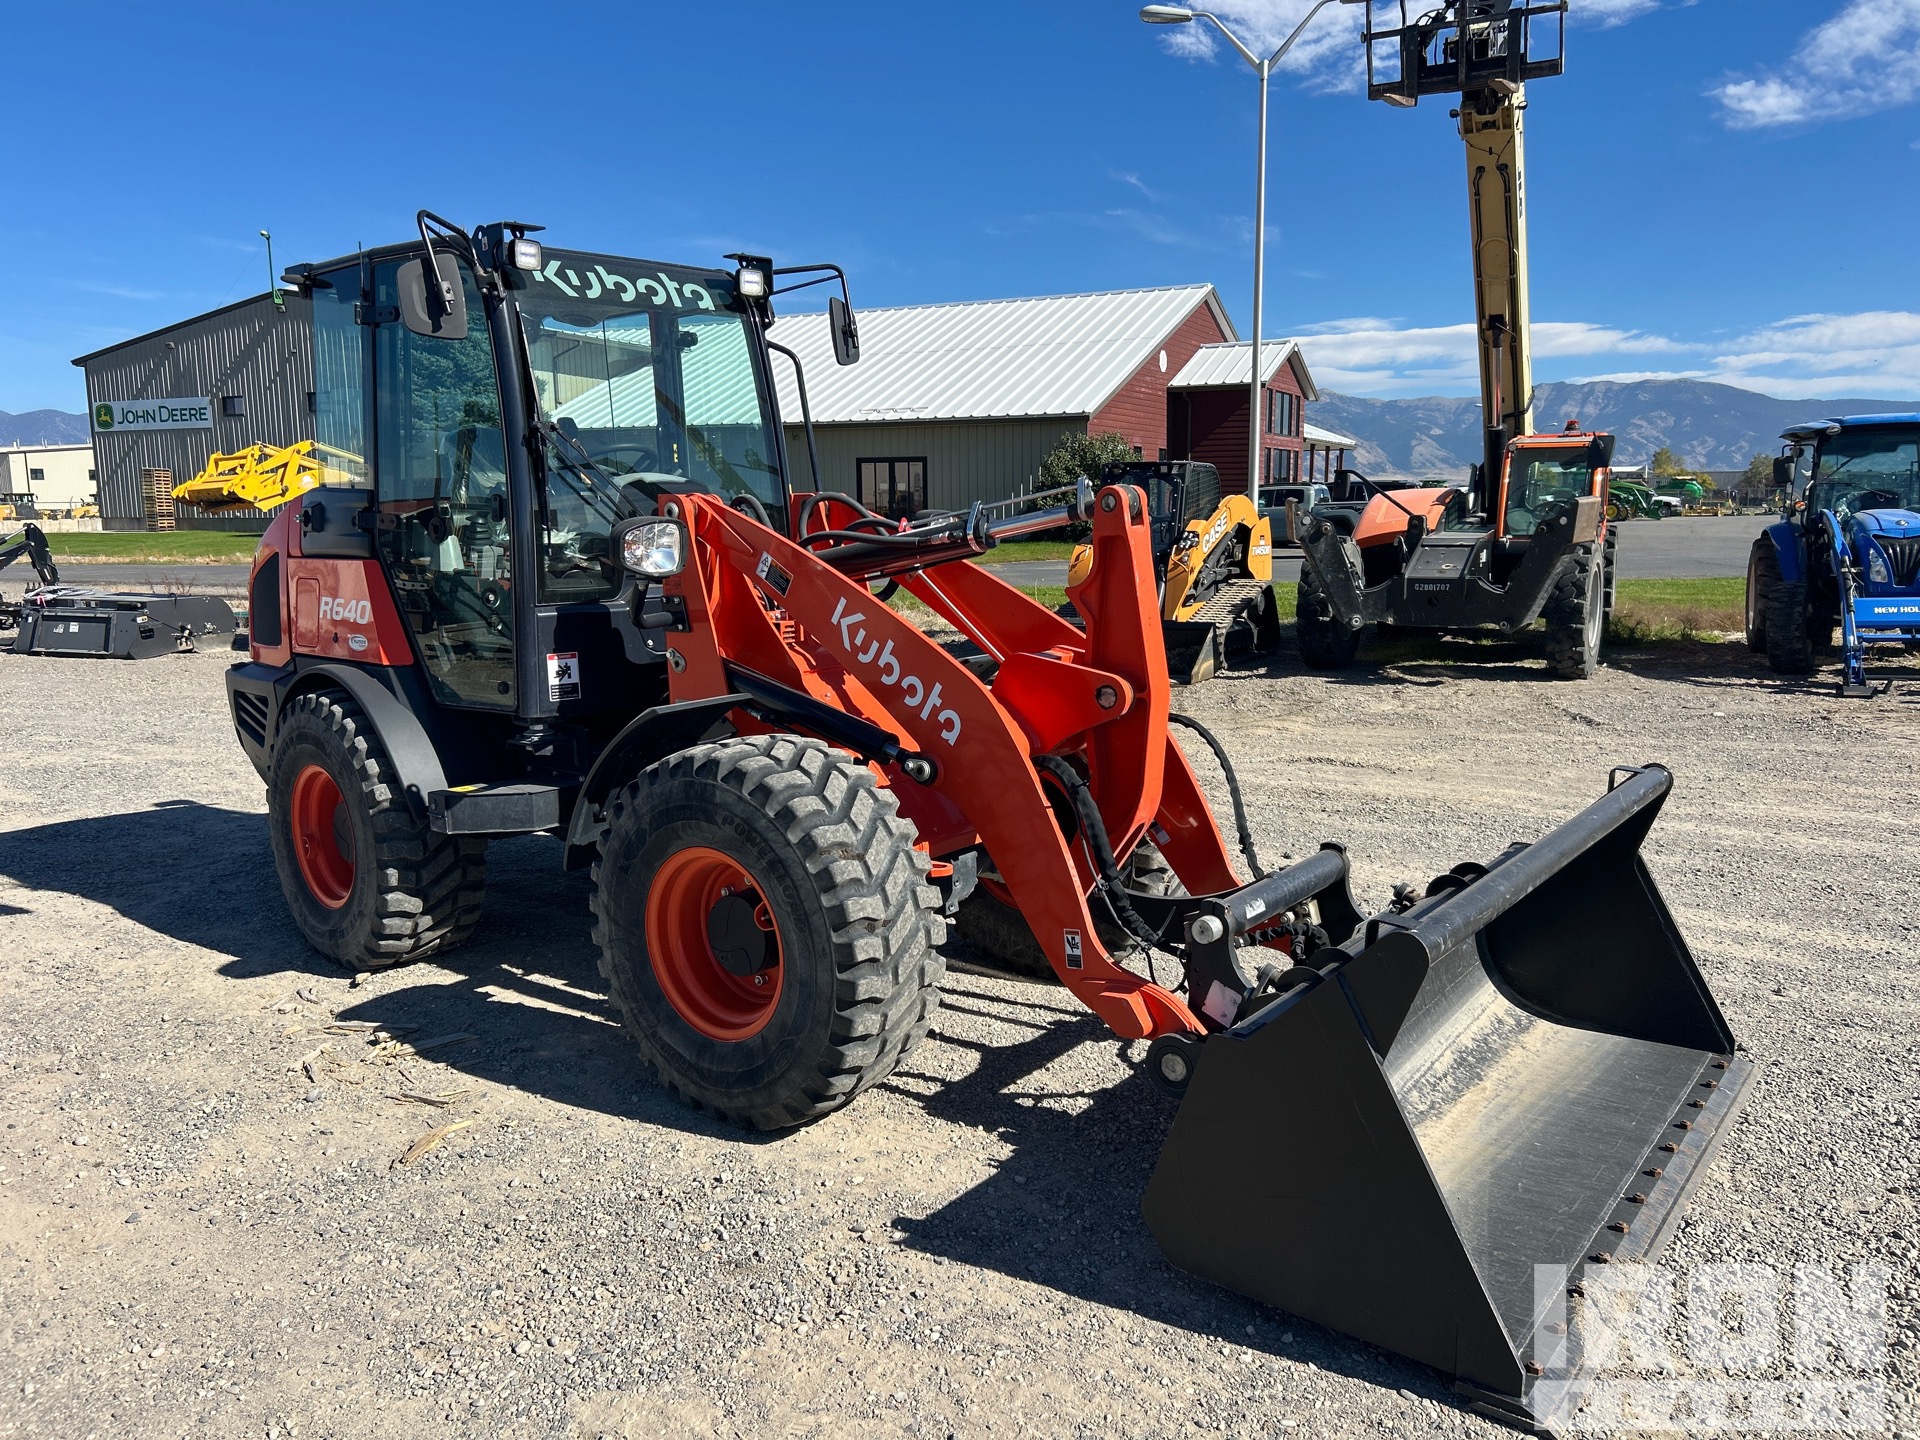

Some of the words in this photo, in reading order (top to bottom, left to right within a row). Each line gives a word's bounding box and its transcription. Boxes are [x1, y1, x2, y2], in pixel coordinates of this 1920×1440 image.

[532, 260, 716, 311] Kubota
[117, 407, 156, 425] JOHN
[159, 405, 209, 422] DEERE
[1202, 511, 1228, 554] CASE
[319, 596, 371, 625] R640
[1873, 606, 1898, 614] NEW
[831, 596, 962, 747] Kubota
